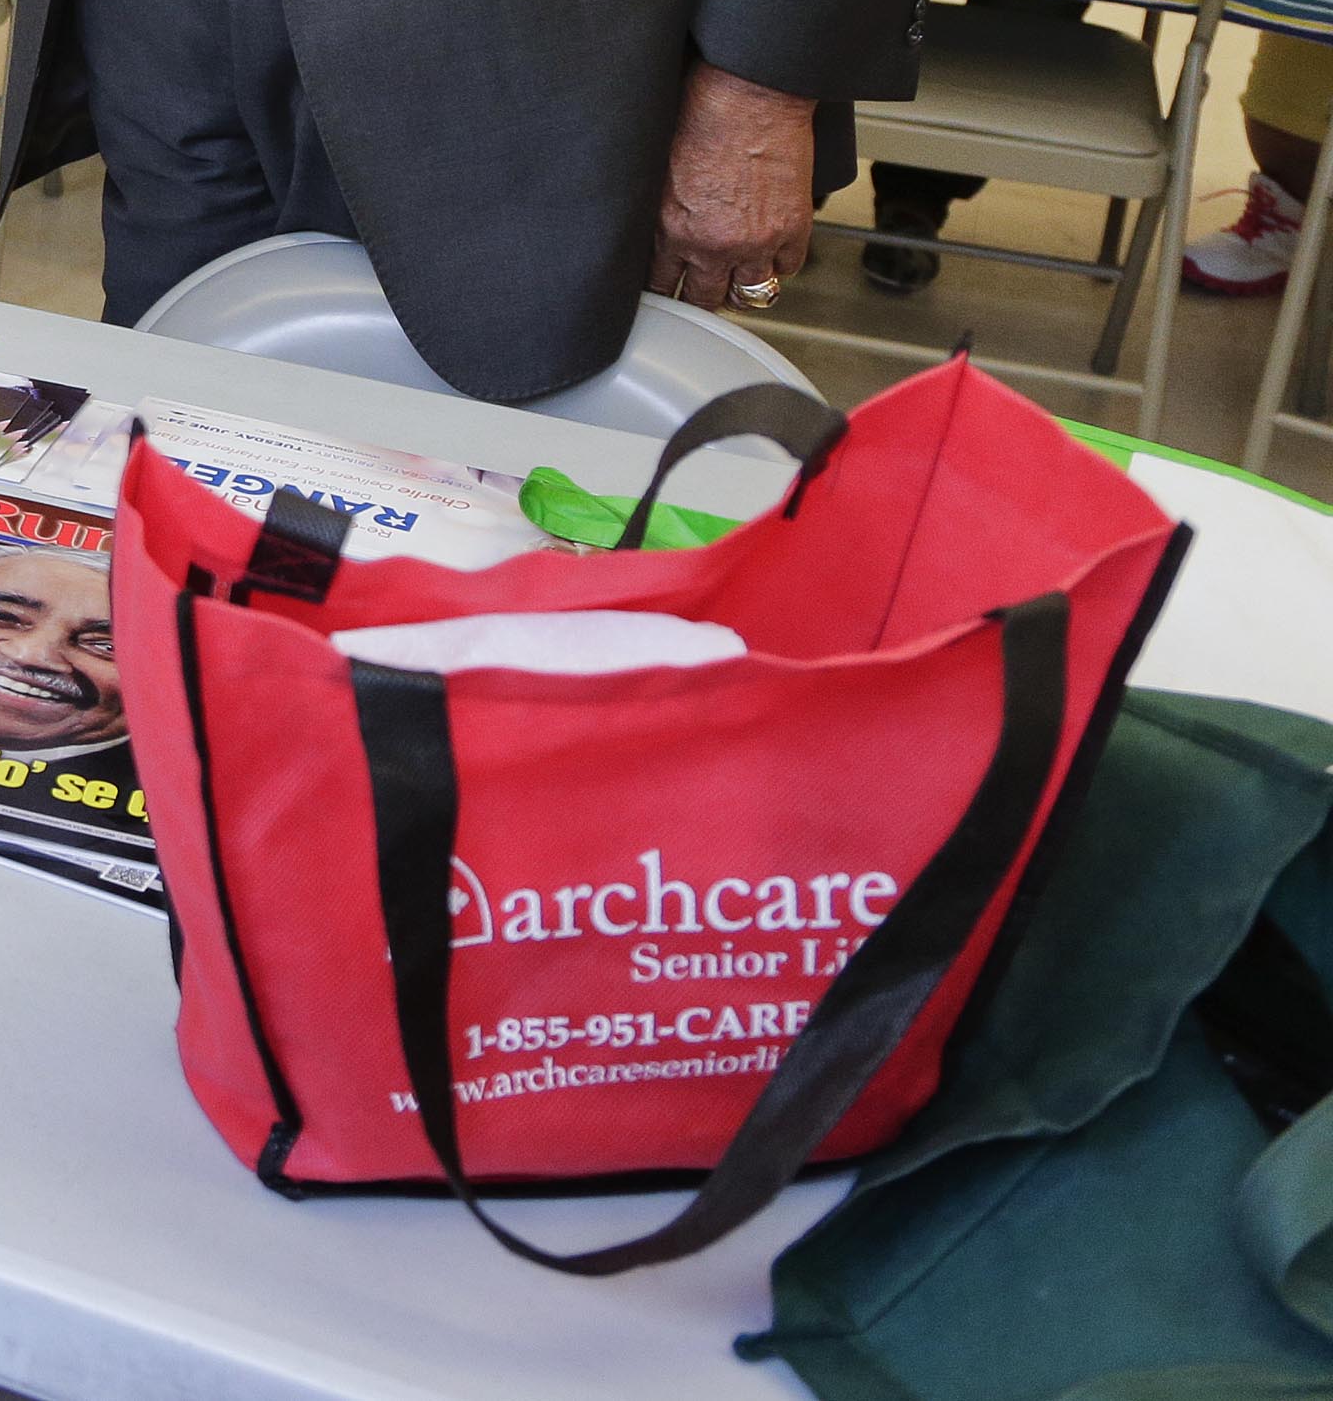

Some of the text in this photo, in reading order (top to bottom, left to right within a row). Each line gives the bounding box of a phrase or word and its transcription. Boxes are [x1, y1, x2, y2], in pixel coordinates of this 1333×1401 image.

[189, 421, 230, 435] JUNE
[234, 430, 304, 452] TUESDAY,
[213, 458, 278, 478] Congress
[264, 455, 301, 469] East
[305, 463, 326, 475] for
[315, 450, 374, 468] PRIMARY
[329, 470, 394, 491] Delivers
[382, 465, 474, 491] DEMOCRATIC
[302, 479, 373, 500] Democrat
[398, 486, 471, 510] Charlie
[51, 773, 119, 810] se
[500, 848, 898, 944] archcare
[630, 940, 789, 984] Senior
